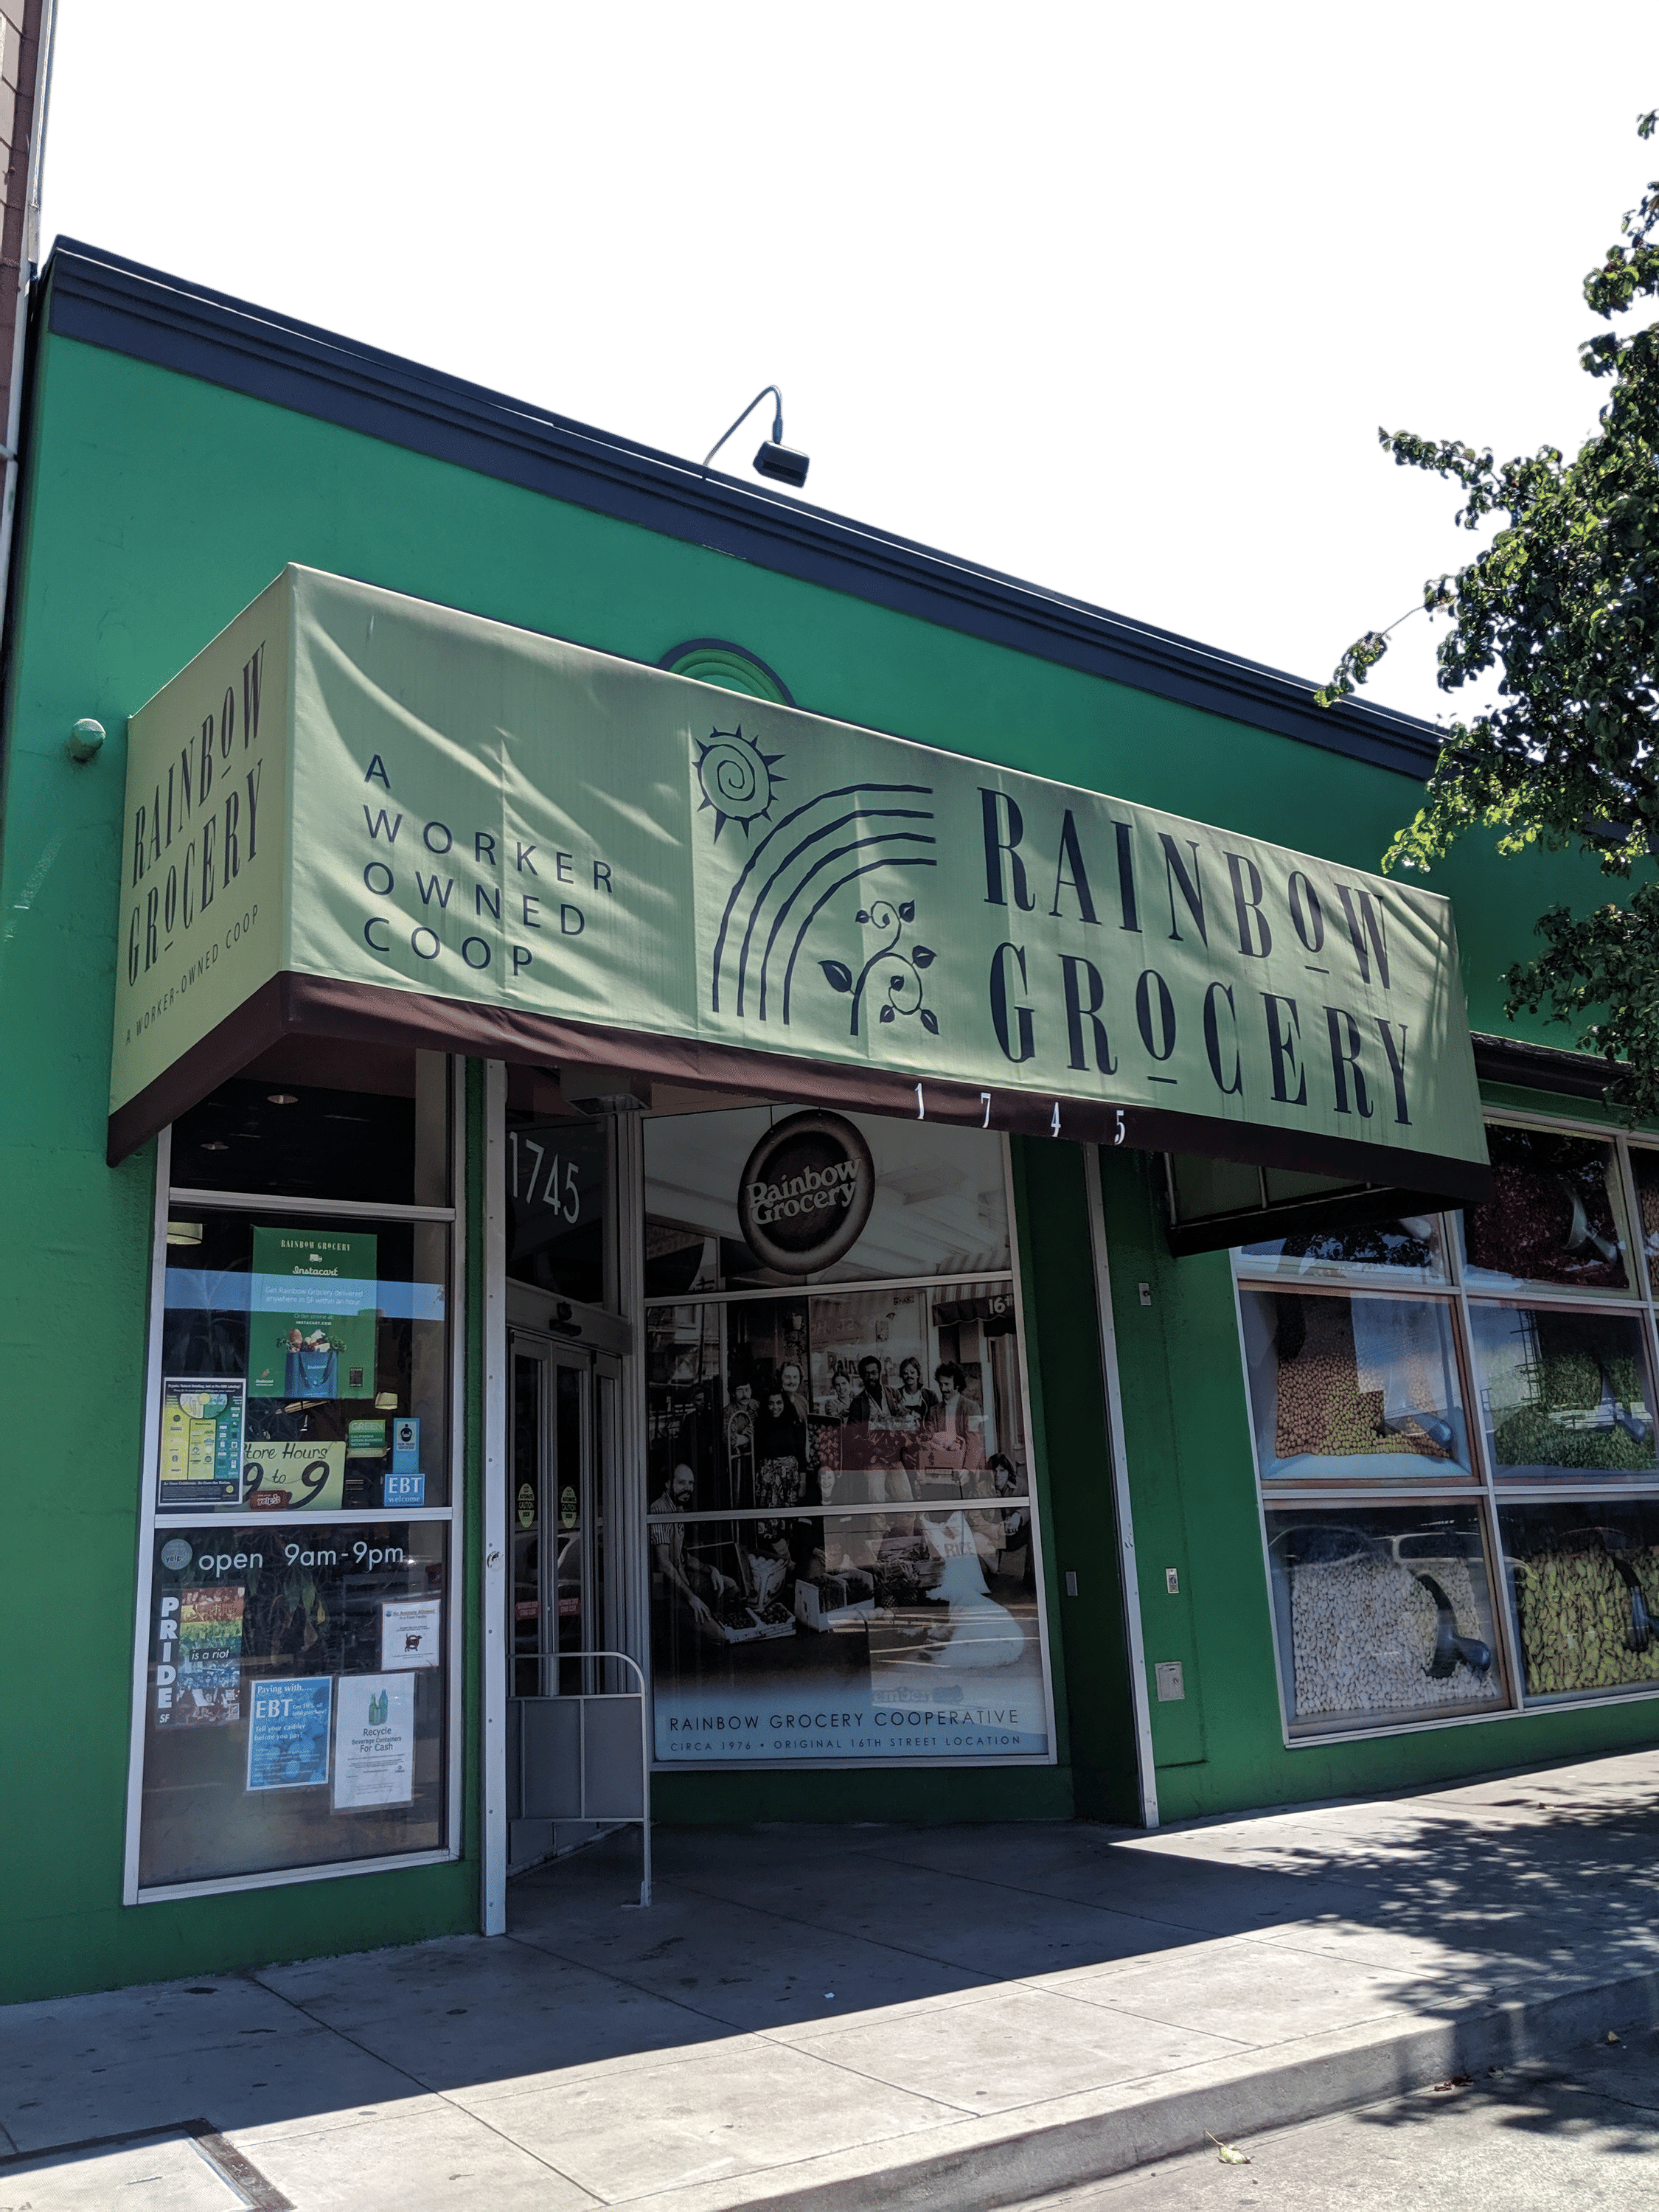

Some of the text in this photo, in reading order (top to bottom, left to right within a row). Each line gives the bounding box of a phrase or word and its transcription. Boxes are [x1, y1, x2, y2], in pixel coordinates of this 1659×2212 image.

[132, 640, 267, 889] RAINBOW
[364, 754, 391, 790] A
[363, 804, 613, 894] WORKER
[128, 759, 263, 987] GROCERY
[364, 861, 586, 936] OWNED
[977, 786, 1391, 990] RAINBOW
[364, 917, 533, 977] COOP
[126, 1029, 131, 1045] A
[226, 903, 259, 950] COOP
[990, 942, 1413, 1127] GROCERY
[509, 1130, 580, 1225] 1745
[746, 1158, 862, 1209] Rainbow
[751, 1181, 857, 1225] Grocery
[280, 1239, 352, 1251] RAINBOW GROCERY
[293, 1265, 338, 1276] Instacart
[265, 1286, 364, 1298] Get Rainbow Grocery delivered
[265, 1295, 298, 1304] anywhere
[351, 1422, 383, 1431] GREEN
[282, 1442, 328, 1460] Hours
[272, 1469, 287, 1484] to
[288, 1460, 330, 1510] 9
[388, 1477, 422, 1494] EBT
[518, 1501, 535, 1509] CAUTION
[165, 1554, 182, 1562] yelp
[198, 1551, 263, 1578] open
[156, 1596, 179, 1710] PRIDE
[191, 1648, 230, 1660] is a riot
[257, 1685, 282, 1694] Paying
[159, 1714, 170, 1724] SF
[255, 1698, 293, 1719] EBT
[669, 1709, 1019, 1731] RAINBOW GROCERY COOPERATIVE
[363, 1726, 392, 1736] Recycle
[360, 1742, 393, 1753] For Cash
[670, 1736, 1020, 1752] CIRCA 1976 ORIGINAL 16TH STREET LOCATION
